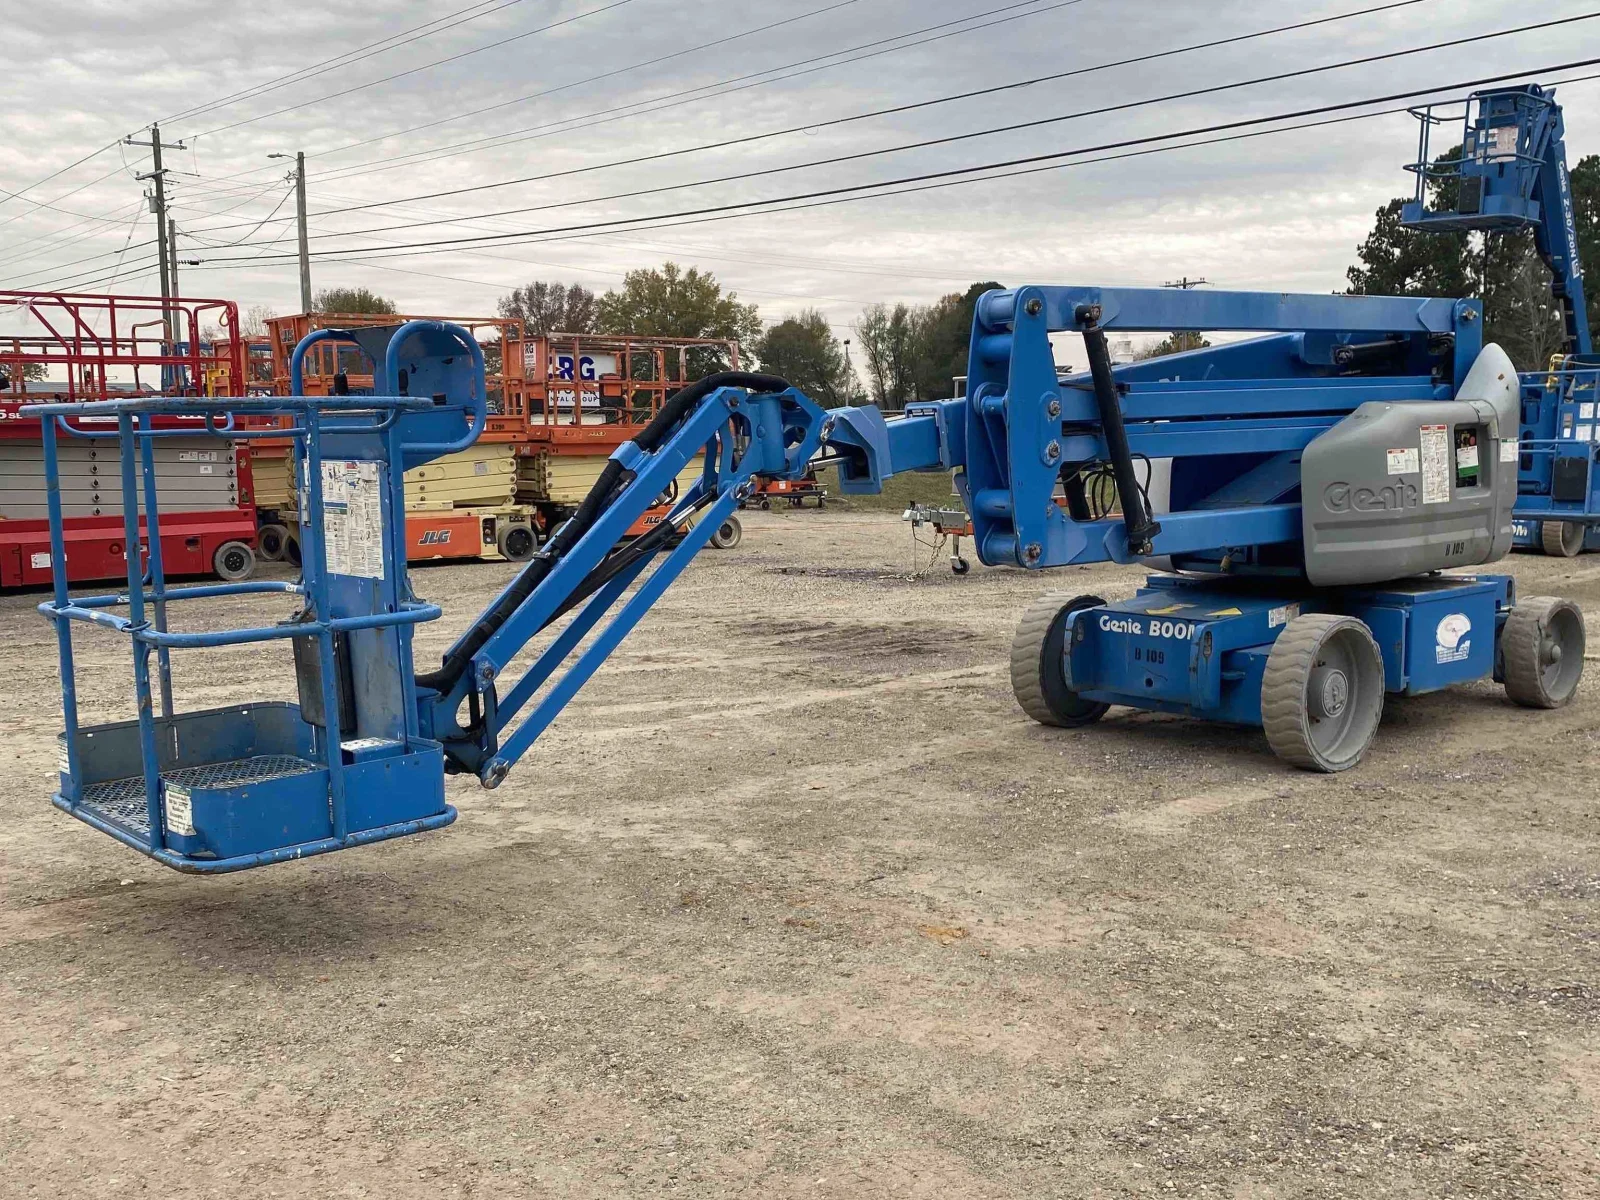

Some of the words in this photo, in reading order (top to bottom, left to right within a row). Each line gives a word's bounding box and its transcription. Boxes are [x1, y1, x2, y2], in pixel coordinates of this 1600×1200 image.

[548, 356, 596, 382] RG
[1322, 477, 1417, 514] Genie
[418, 529, 452, 545] JLG
[1100, 615, 1142, 635] Genie
[1146, 648, 1165, 664] 109
